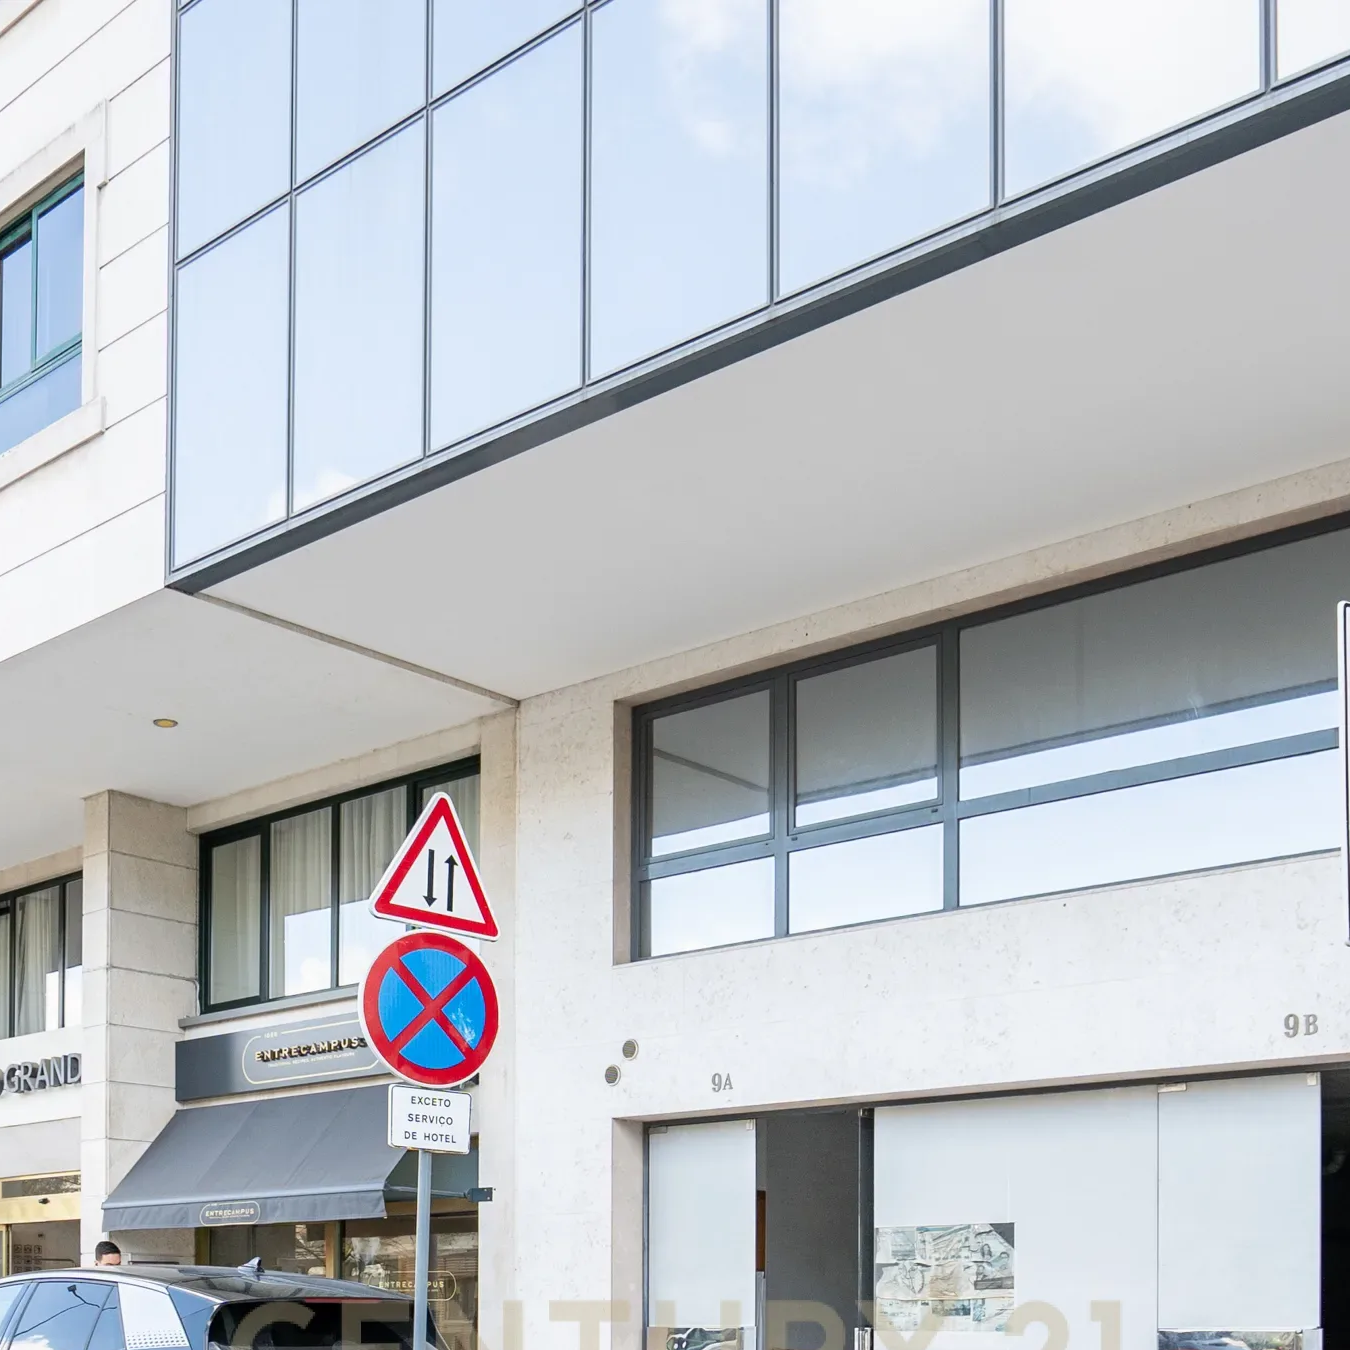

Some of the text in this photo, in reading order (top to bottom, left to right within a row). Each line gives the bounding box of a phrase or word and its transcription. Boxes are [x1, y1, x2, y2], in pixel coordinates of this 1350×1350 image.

[254, 1036, 360, 1062] ENTRECAMPUS
[4, 1052, 82, 1094] GRAND
[410, 1095, 452, 1108] EXCETO
[407, 1113, 454, 1128] SERVIÇO
[404, 1131, 457, 1144] DE HOTEL
[205, 1207, 255, 1217] ENTRECAMPUS
[378, 1280, 445, 1289] ENTRECPUS
